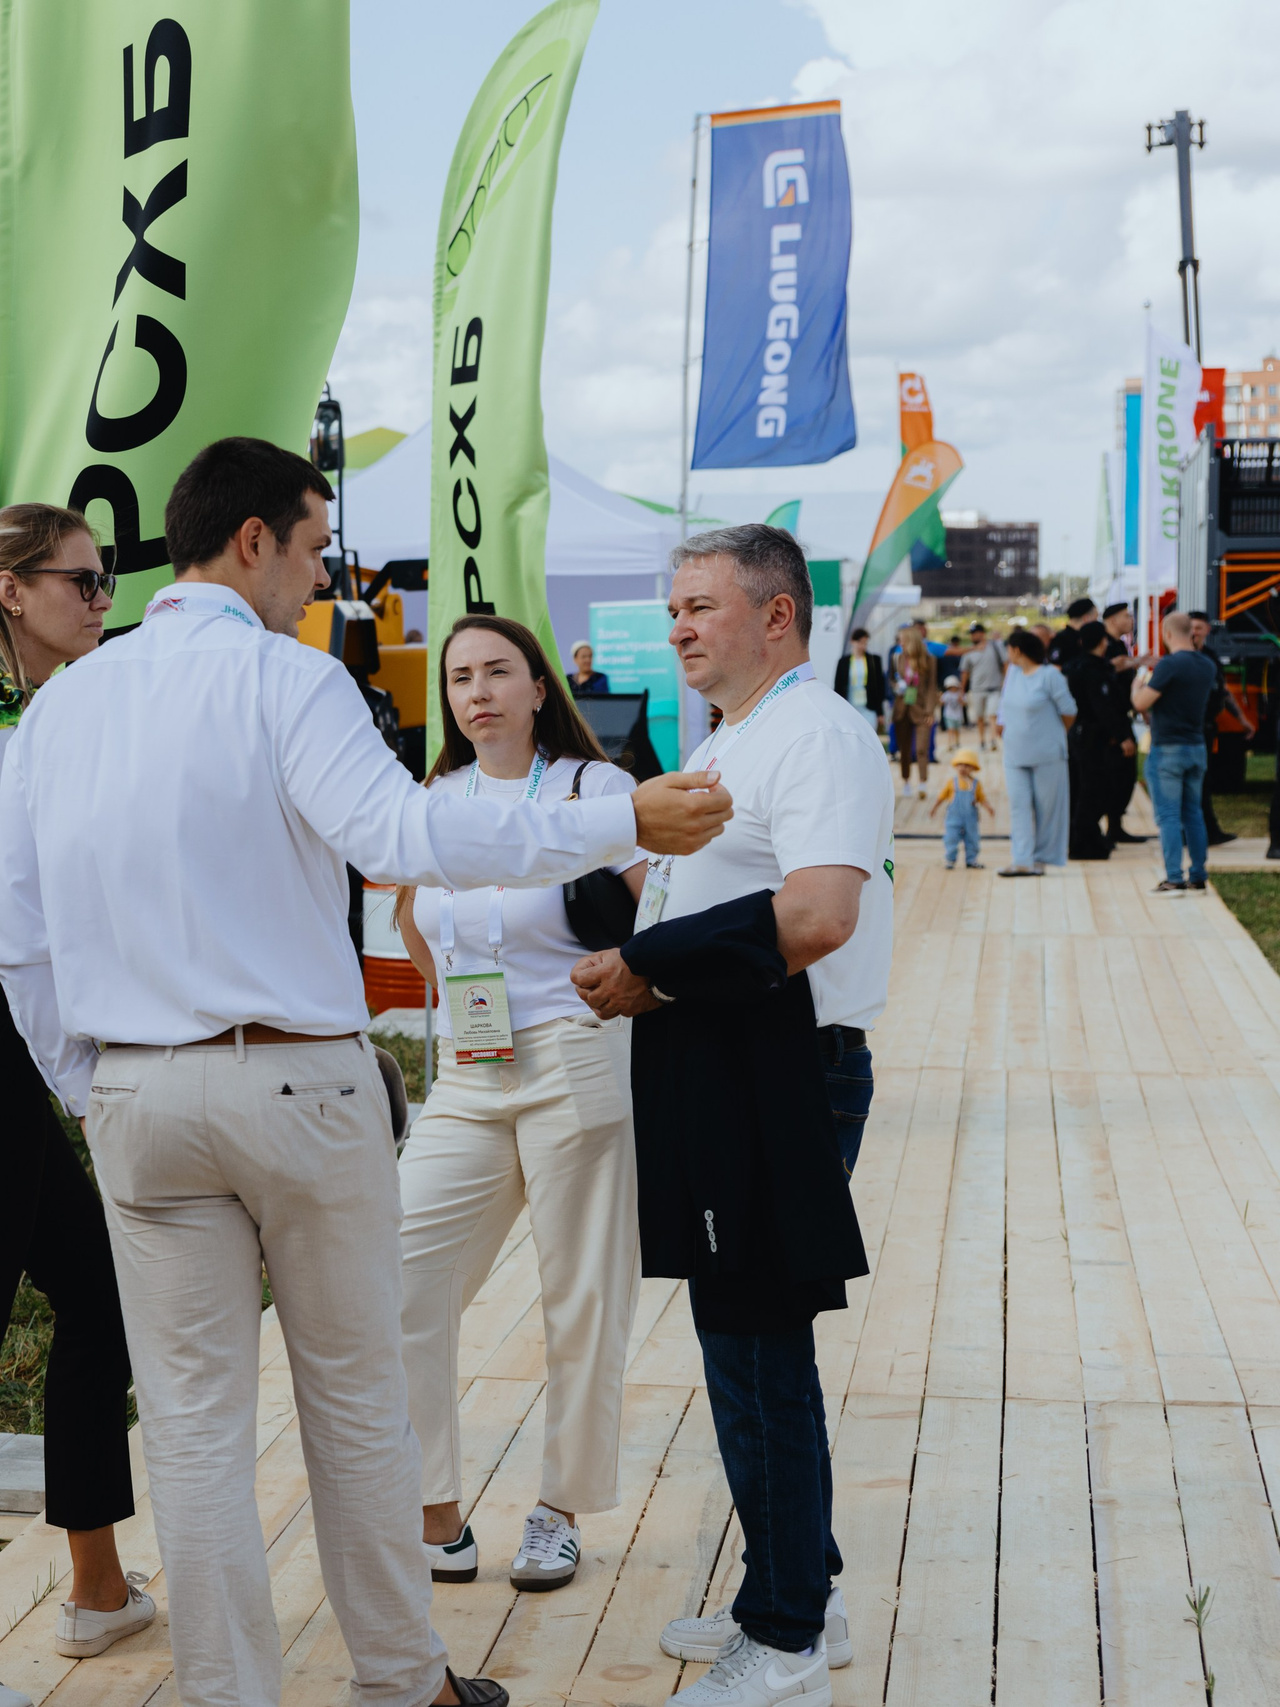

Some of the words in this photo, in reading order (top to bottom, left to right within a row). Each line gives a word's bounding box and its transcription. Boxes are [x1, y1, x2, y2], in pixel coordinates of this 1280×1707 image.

[67, 18, 192, 576] РСХБ
[756, 222, 802, 438] LIUGONG
[449, 316, 496, 616] РСХБ
[1157, 357, 1181, 498] KRONE
[737, 671, 800, 735] РОСАГРОЛИЗИНГ
